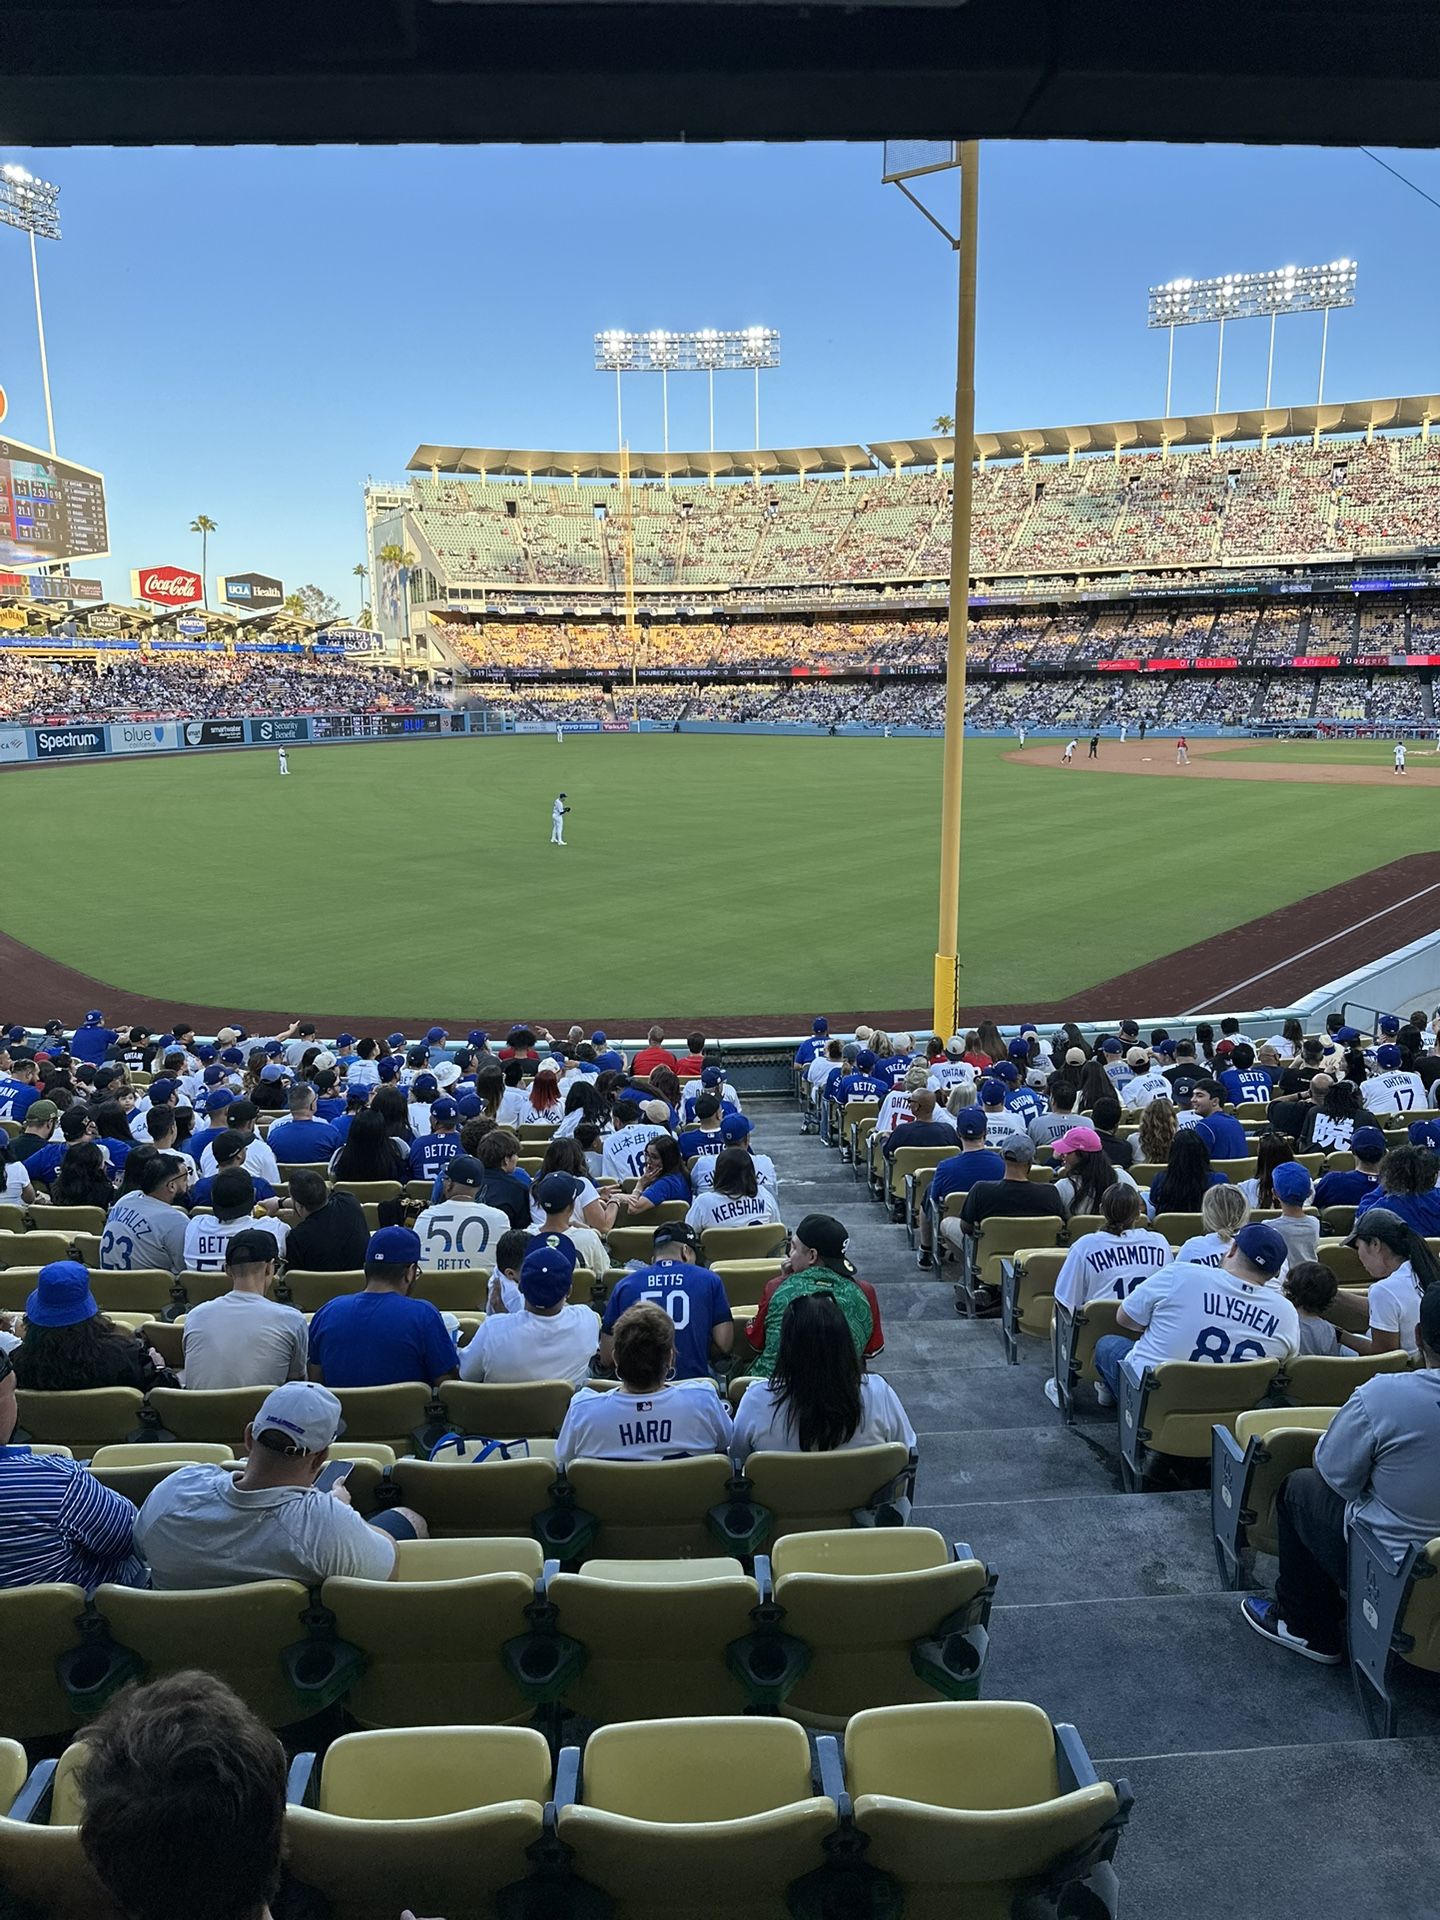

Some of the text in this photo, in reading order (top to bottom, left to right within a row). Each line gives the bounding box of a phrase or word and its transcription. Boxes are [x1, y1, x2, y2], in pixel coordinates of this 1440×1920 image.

[228, 585, 281, 598] UCLA Health
[274, 721, 298, 731] Security
[124, 727, 152, 742] blue
[275, 730, 296, 738] Benefit
[38, 733, 97, 752] Spectrum
[941, 1068, 967, 1078] OHTANI
[1238, 1072, 1265, 1083] BETTS
[853, 1082, 877, 1093] BETTS
[1383, 1076, 1412, 1089] OHTANI
[1241, 1085, 1270, 1103] 50
[1393, 1088, 1415, 1111] 17
[1426, 1136, 1436, 1148] LA
[424, 1143, 458, 1159] BETTS
[711, 1199, 765, 1224] KERSHAW
[101, 1229, 134, 1271] 23
[1086, 1245, 1165, 1273] YAMAMOTO
[647, 1273, 684, 1287] BETTS
[1203, 1291, 1280, 1338] ULYSHEN
[618, 1419, 672, 1447] HARO
